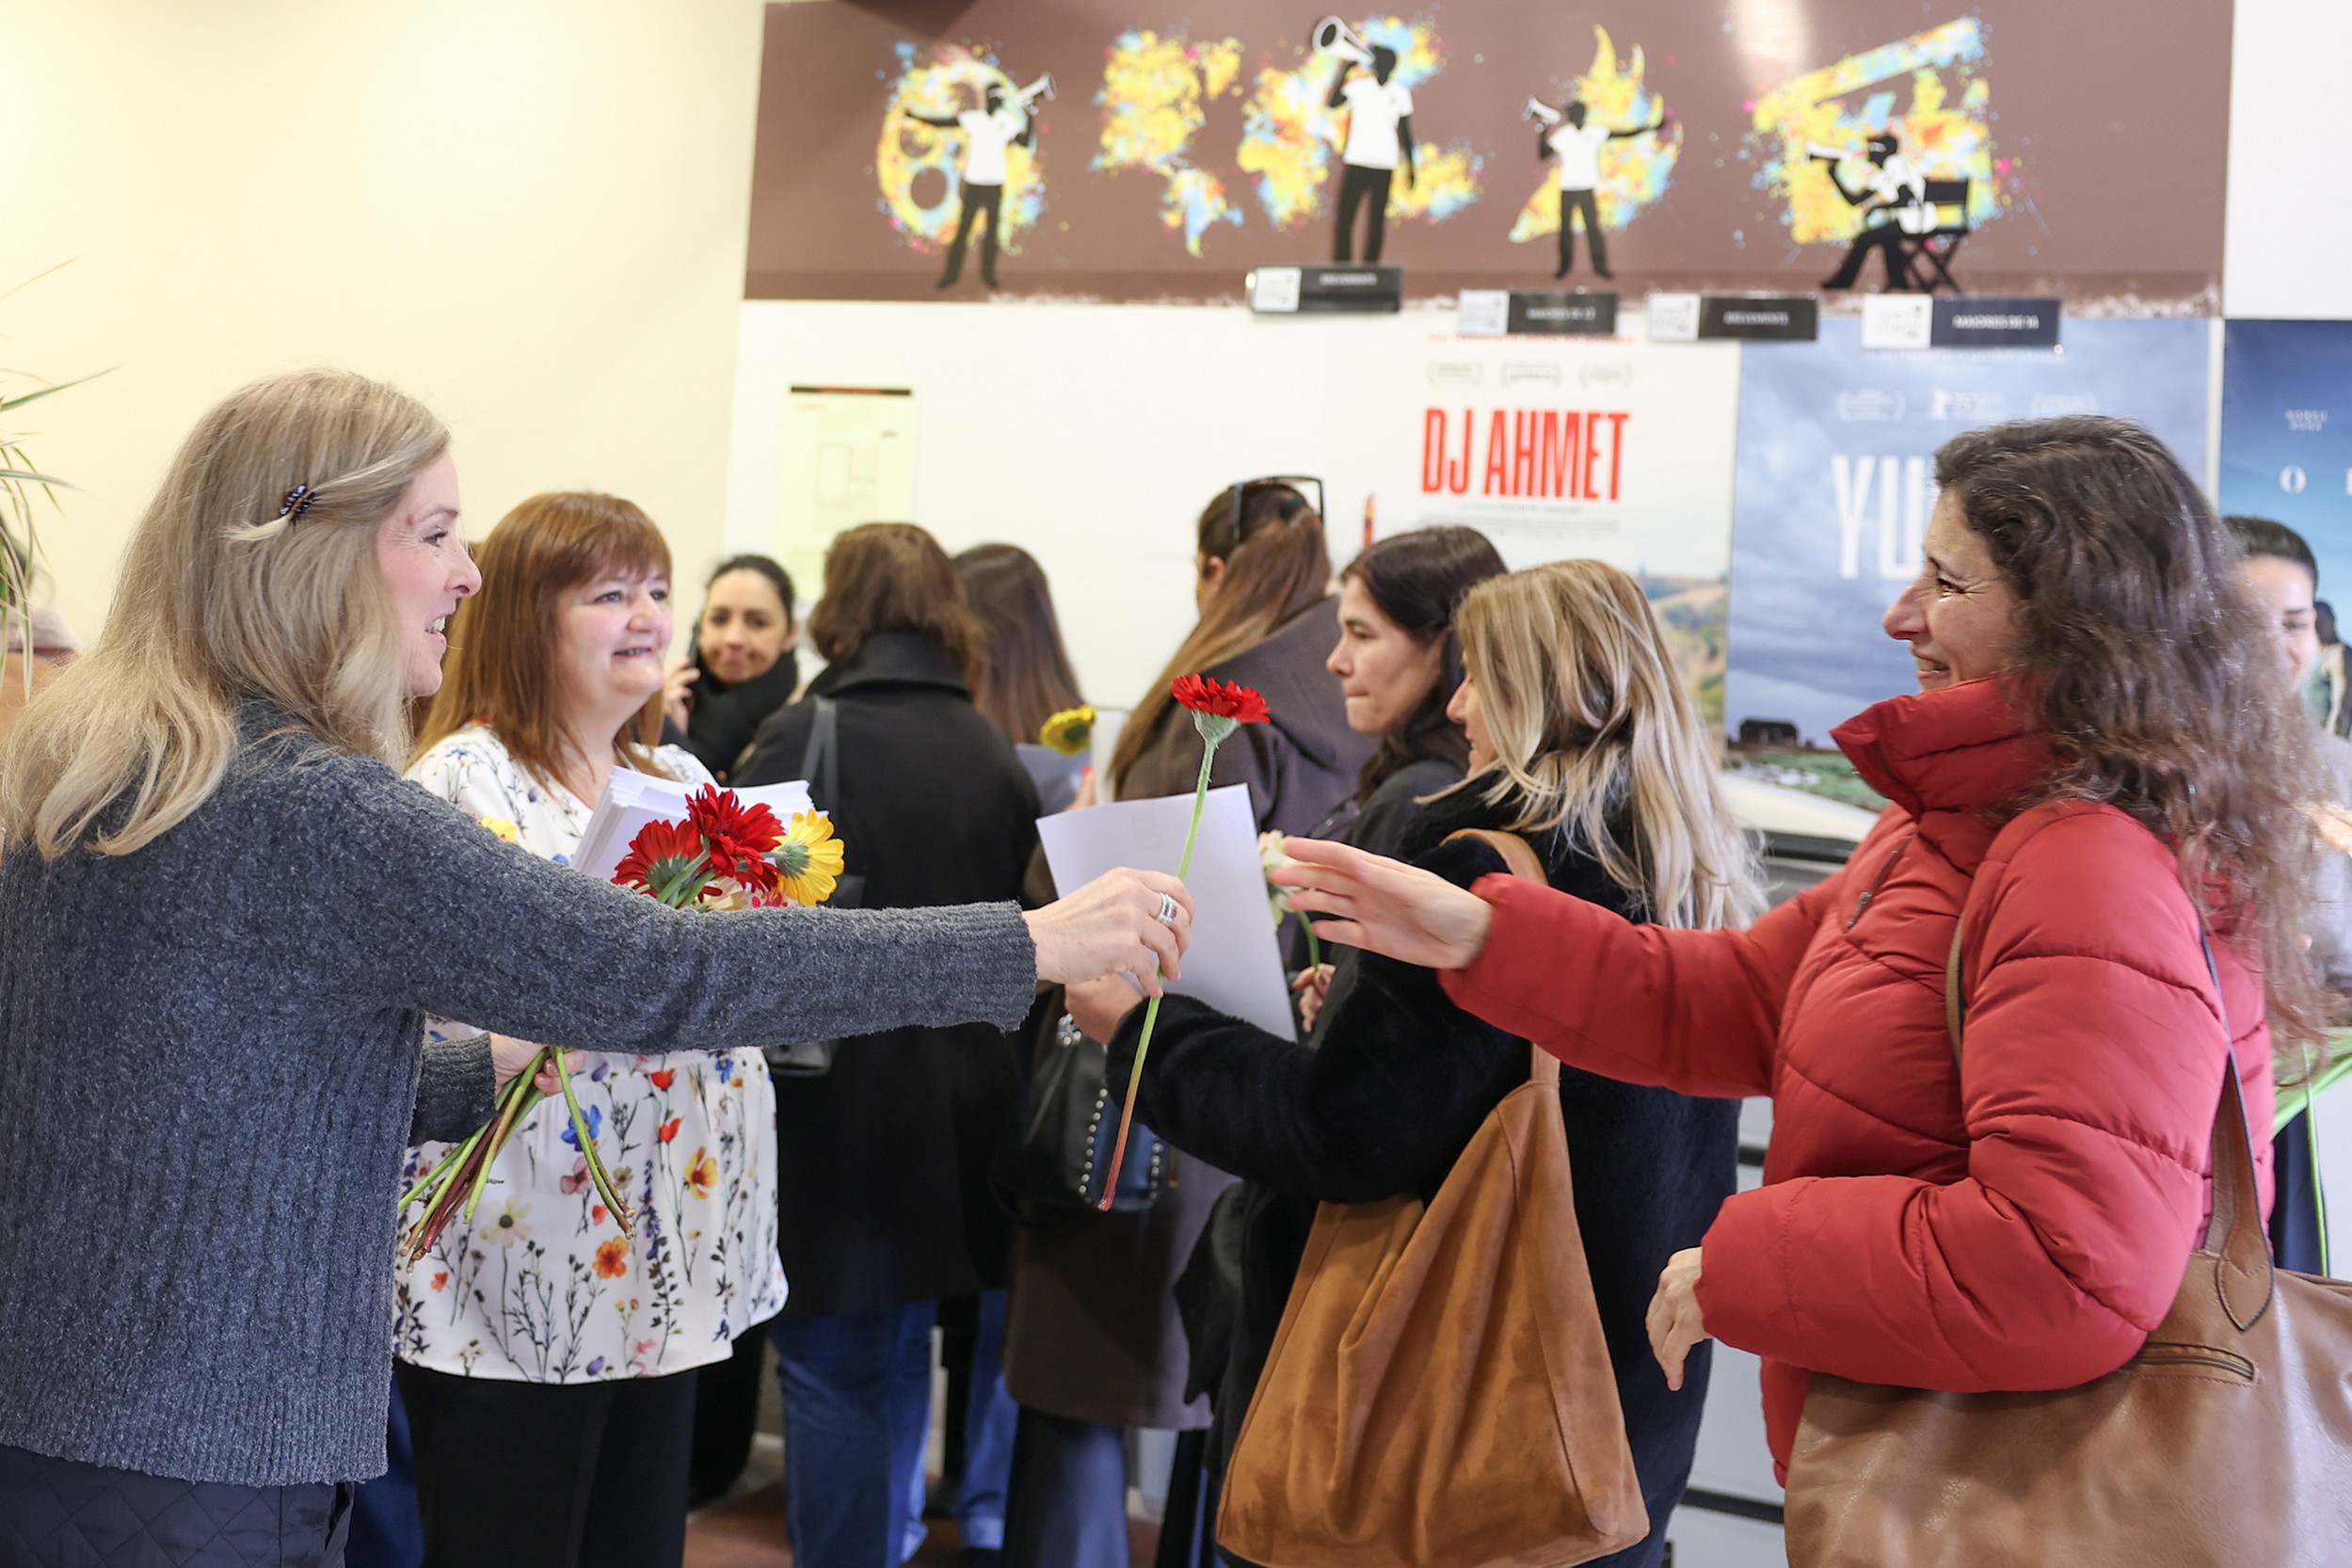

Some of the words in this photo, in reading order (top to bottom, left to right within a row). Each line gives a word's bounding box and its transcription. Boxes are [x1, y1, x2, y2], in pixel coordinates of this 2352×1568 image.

[1422, 408, 1472, 494] DJ
[1483, 410, 1629, 501] AHMET
[1831, 455, 1937, 580] YU
